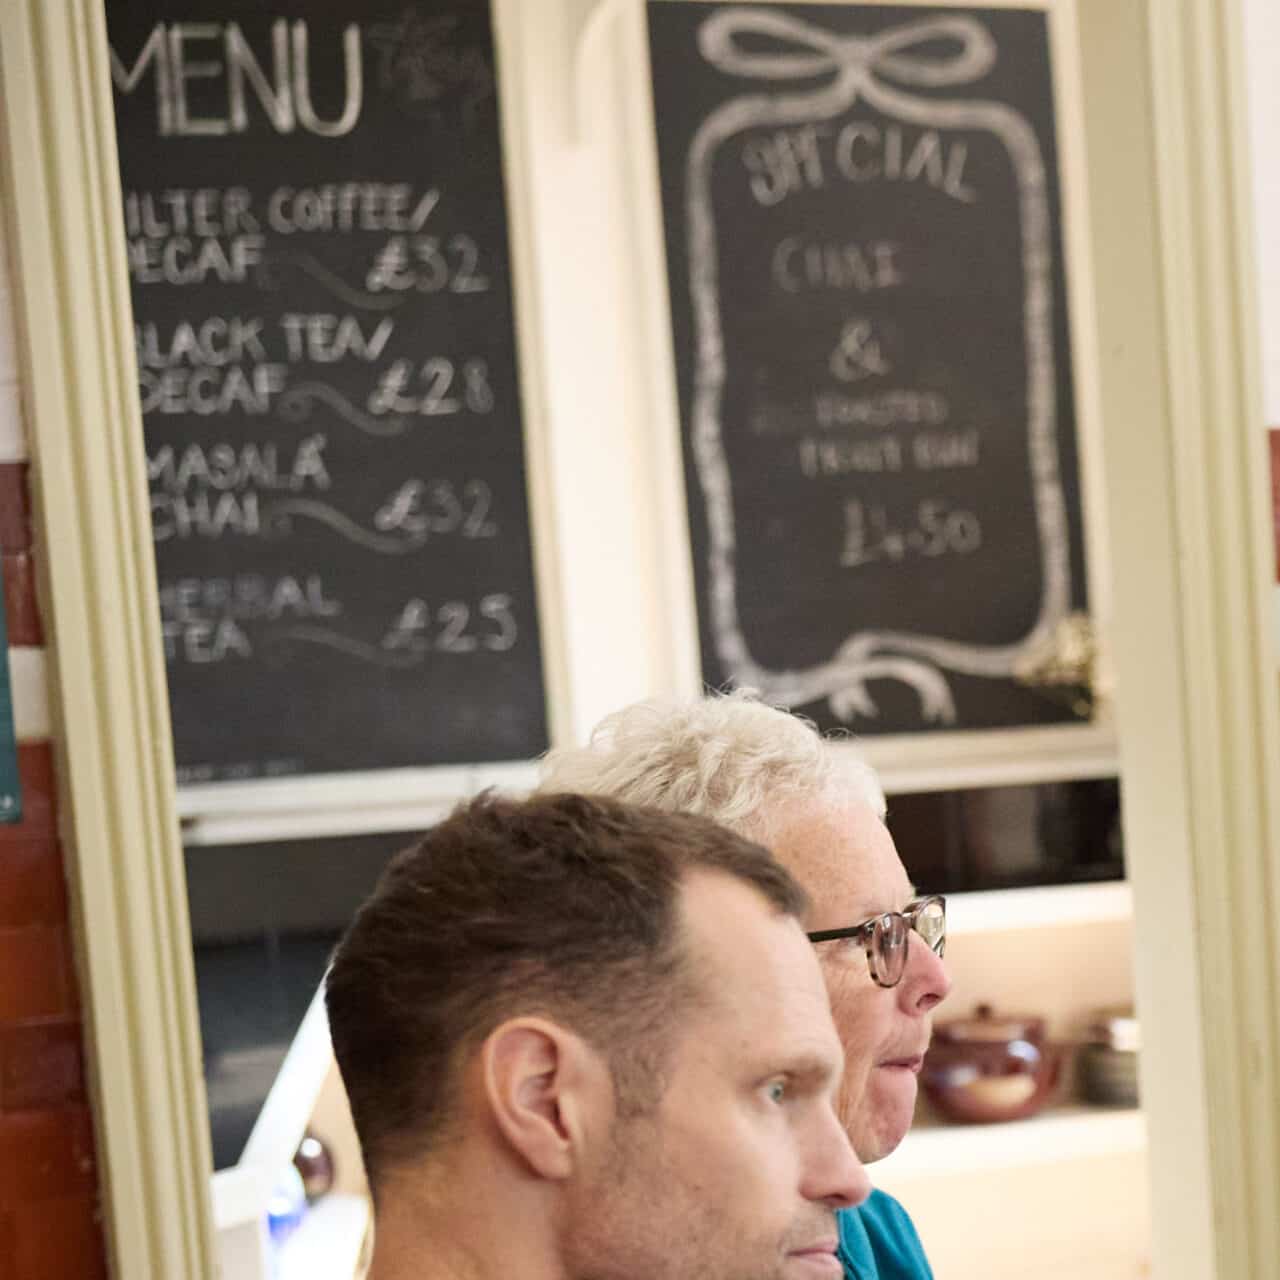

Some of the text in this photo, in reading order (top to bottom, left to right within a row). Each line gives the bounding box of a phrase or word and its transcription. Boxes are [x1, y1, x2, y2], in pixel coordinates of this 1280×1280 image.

[109, 17, 362, 136] MENU
[127, 187, 260, 238] ILTER
[135, 315, 267, 366] LACK
[829, 318, 890, 382] &
